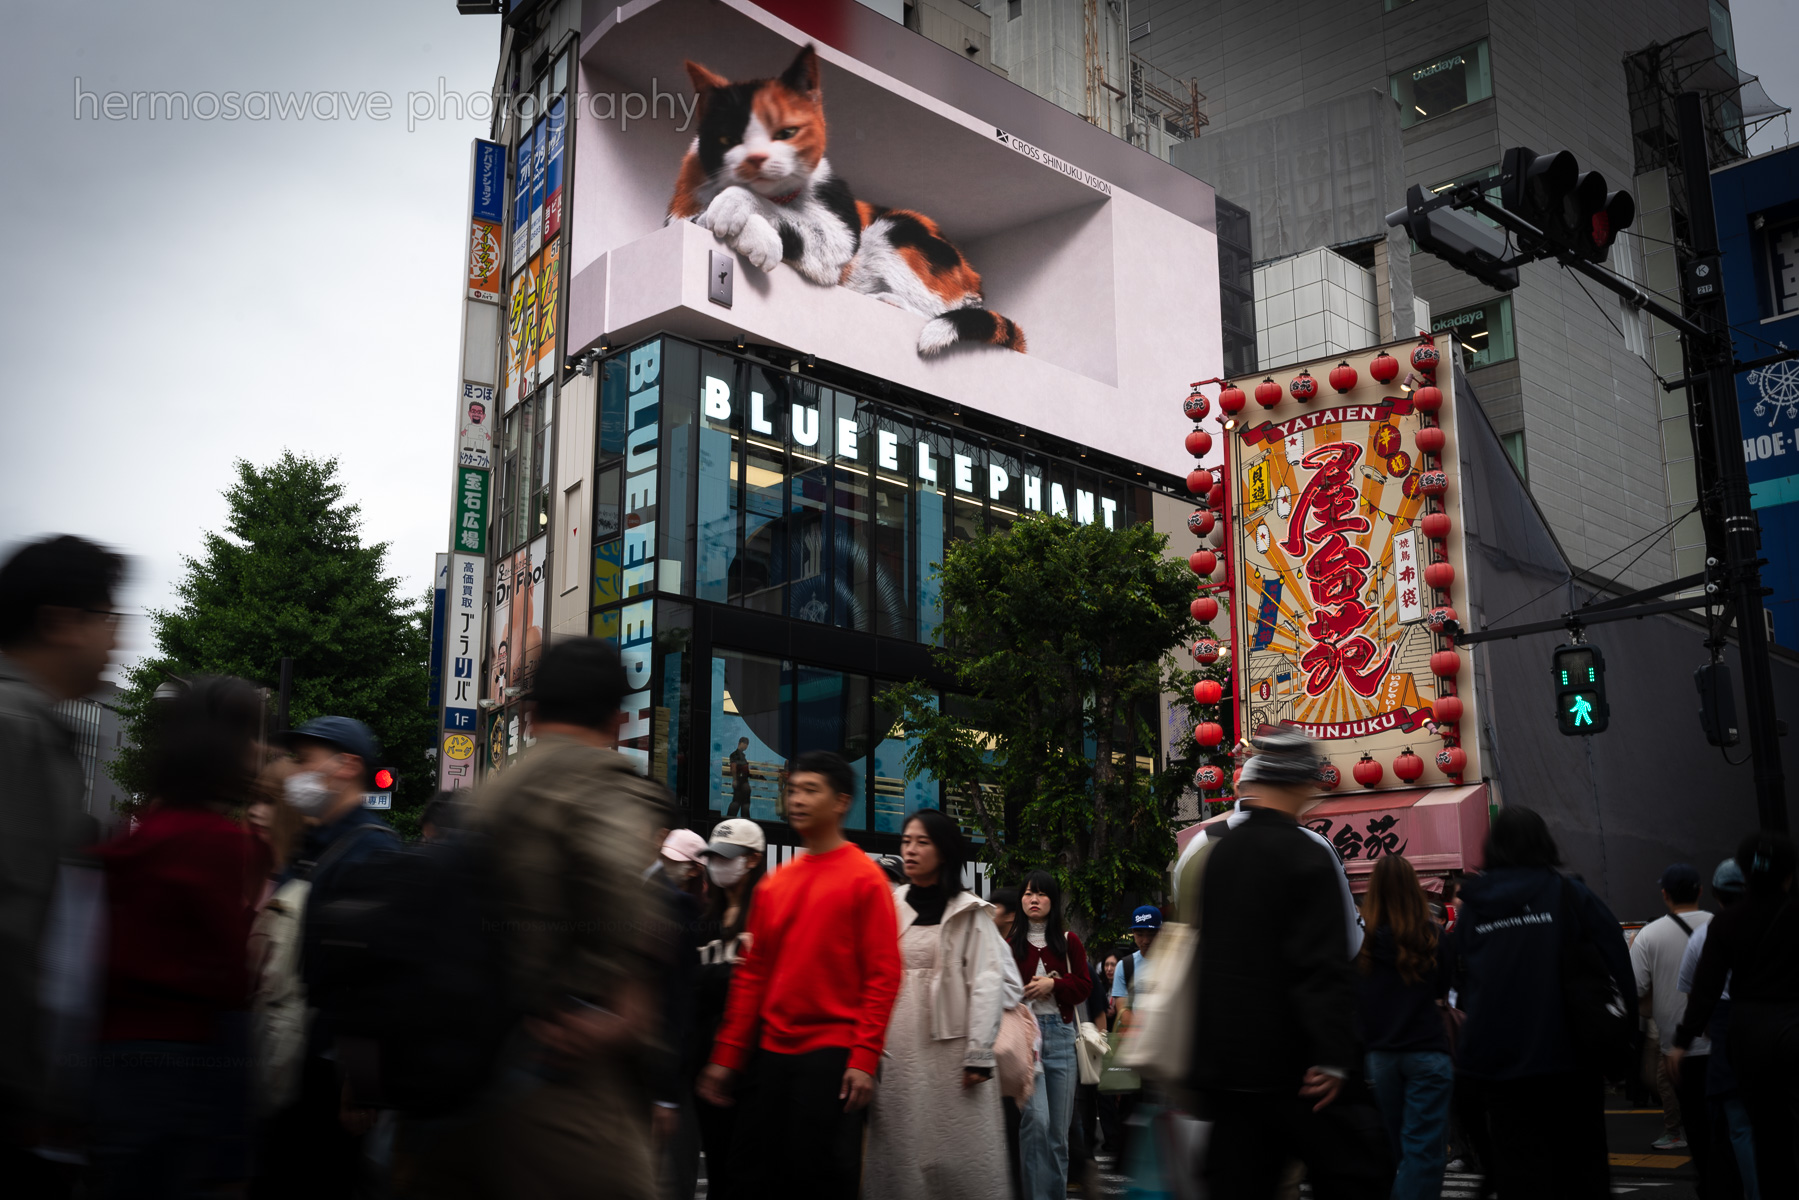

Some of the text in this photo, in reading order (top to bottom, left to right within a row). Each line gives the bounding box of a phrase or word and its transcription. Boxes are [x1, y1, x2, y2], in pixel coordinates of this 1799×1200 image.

[1413, 55, 1461, 80] okadaya
[1012, 139, 1112, 195] CROSS SHINJUKU VISION
[1432, 310, 1484, 332] okadaya
[1277, 407, 1377, 436] YATAIEN
[461, 472, 482, 549] 宝石広場
[461, 561, 475, 608] 高価買取
[1278, 442, 1396, 697] 屋台苑
[454, 612, 475, 702] ブラリバ
[454, 712, 469, 727] 1F
